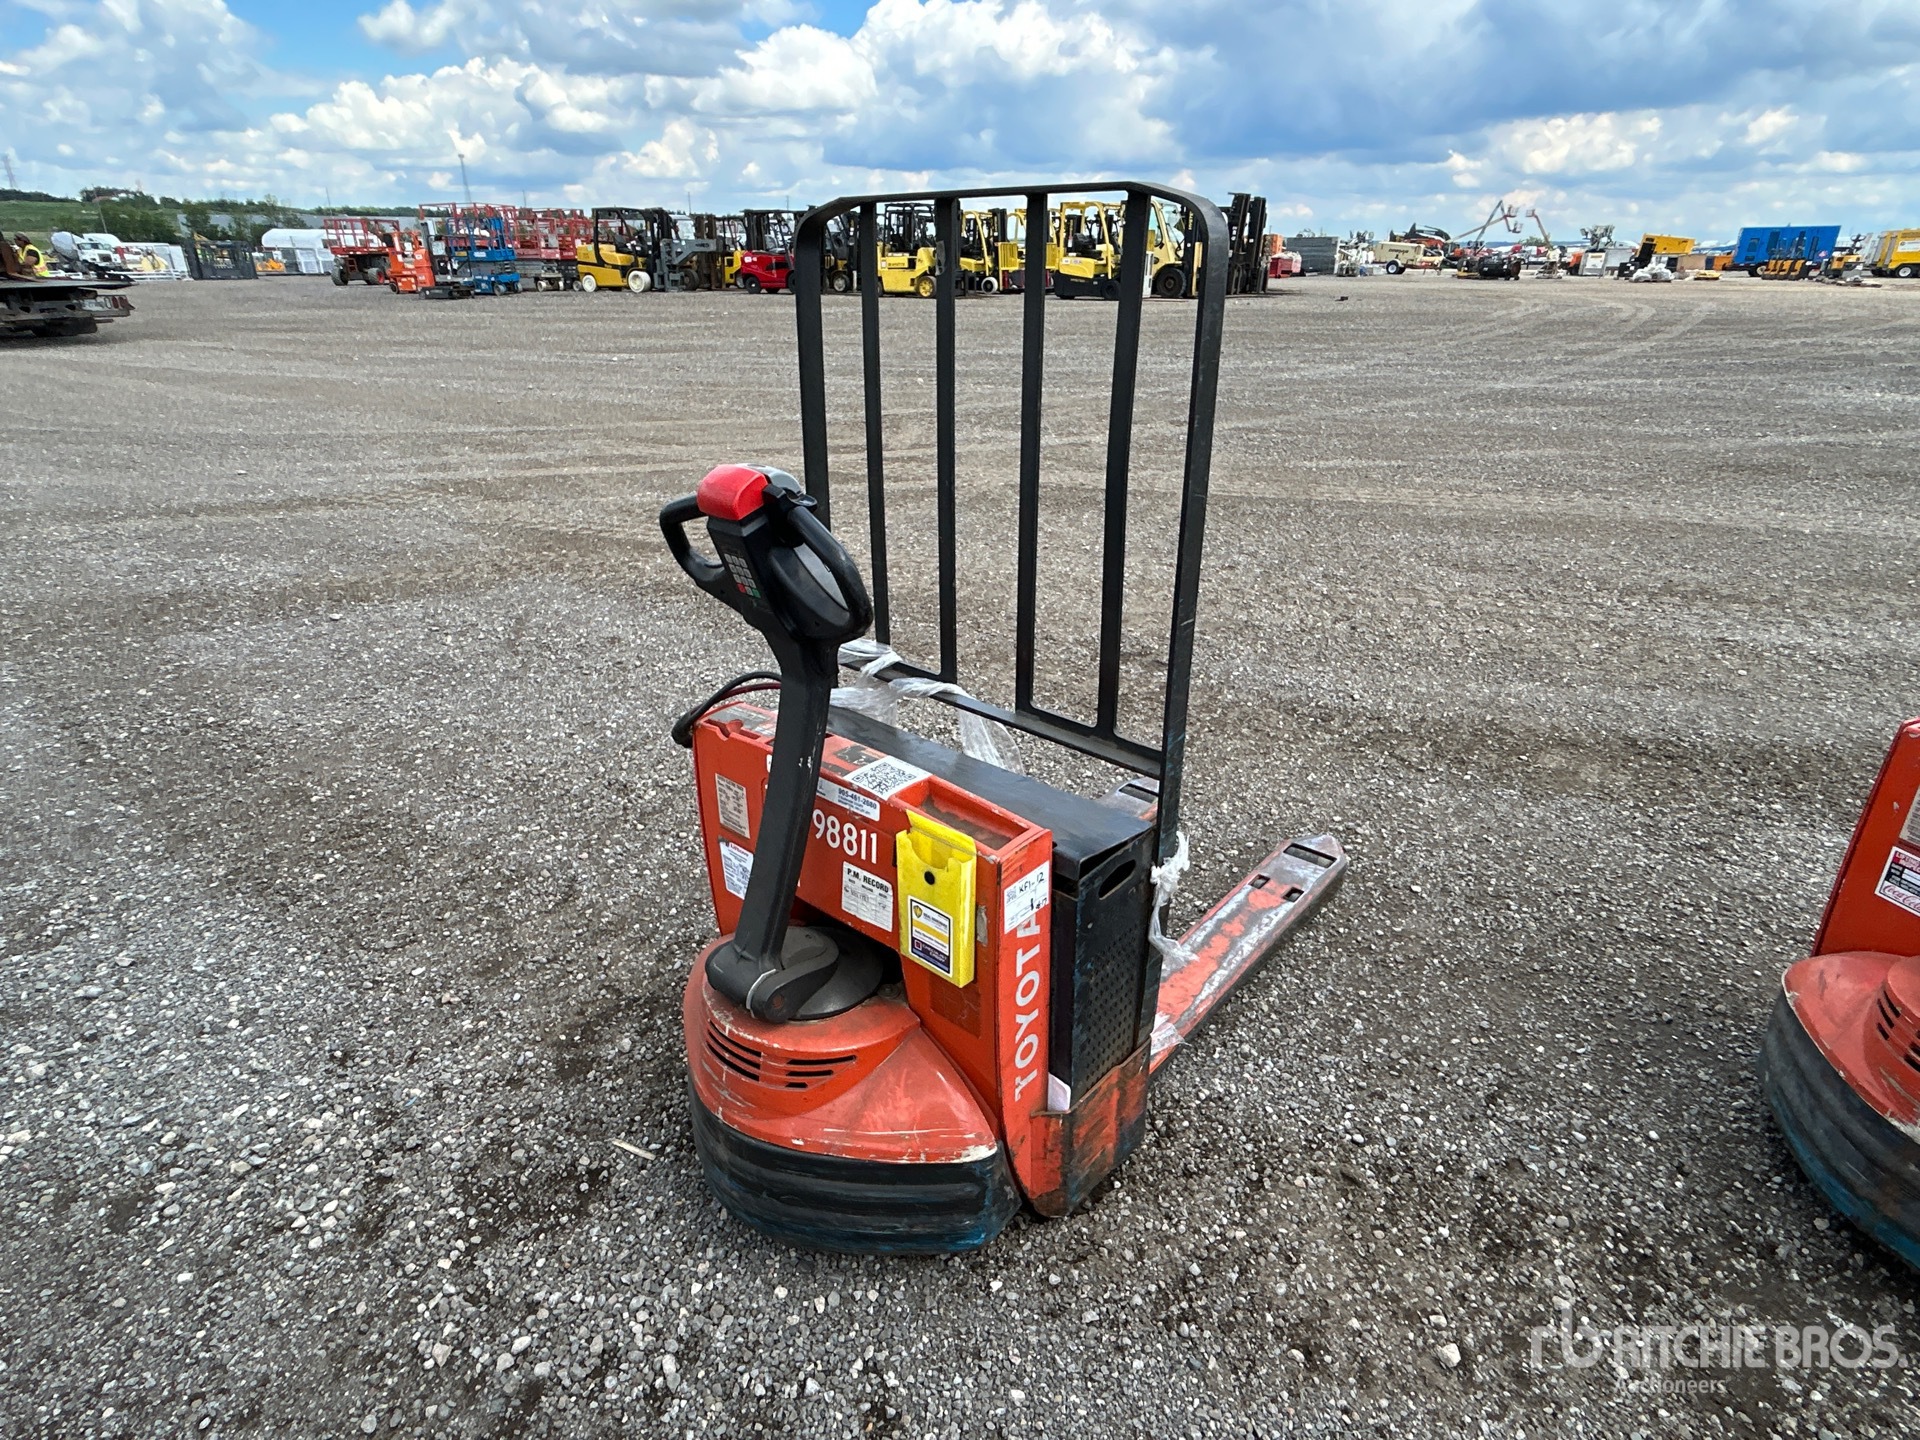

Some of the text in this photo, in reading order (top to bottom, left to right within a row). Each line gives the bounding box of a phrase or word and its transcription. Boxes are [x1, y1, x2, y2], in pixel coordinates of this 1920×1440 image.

[812, 808, 877, 865] 98811
[847, 867, 862, 881] P.M.
[863, 875, 890, 893] RECORD
[1014, 911, 1041, 1102] TOYOTA
